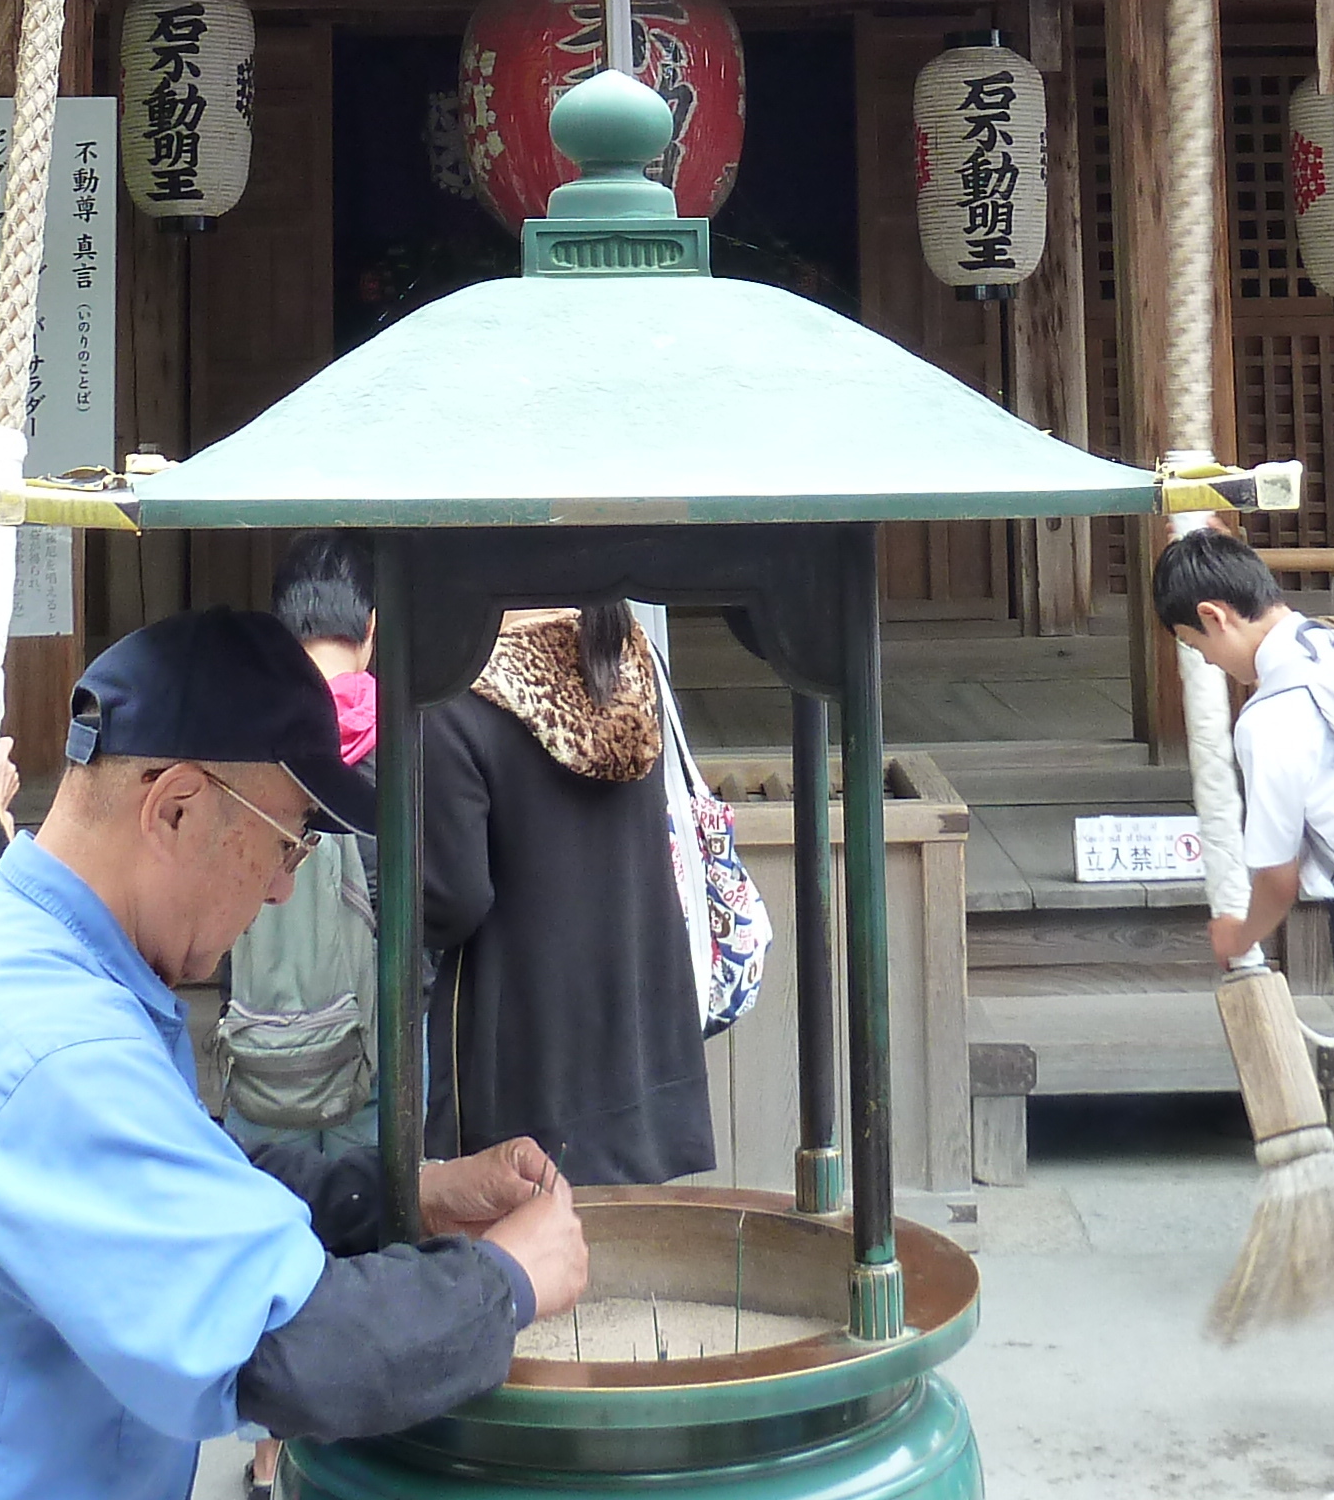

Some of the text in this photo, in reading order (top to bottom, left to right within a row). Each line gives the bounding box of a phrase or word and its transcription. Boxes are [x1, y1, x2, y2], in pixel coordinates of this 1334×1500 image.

[142, 2, 208, 201] 石不動明王
[72, 141, 100, 223] 不動尊
[956, 69, 1017, 272] 石不動明王
[72, 233, 98, 290] 真言
[1084, 845, 1176, 872] 立入禁止
